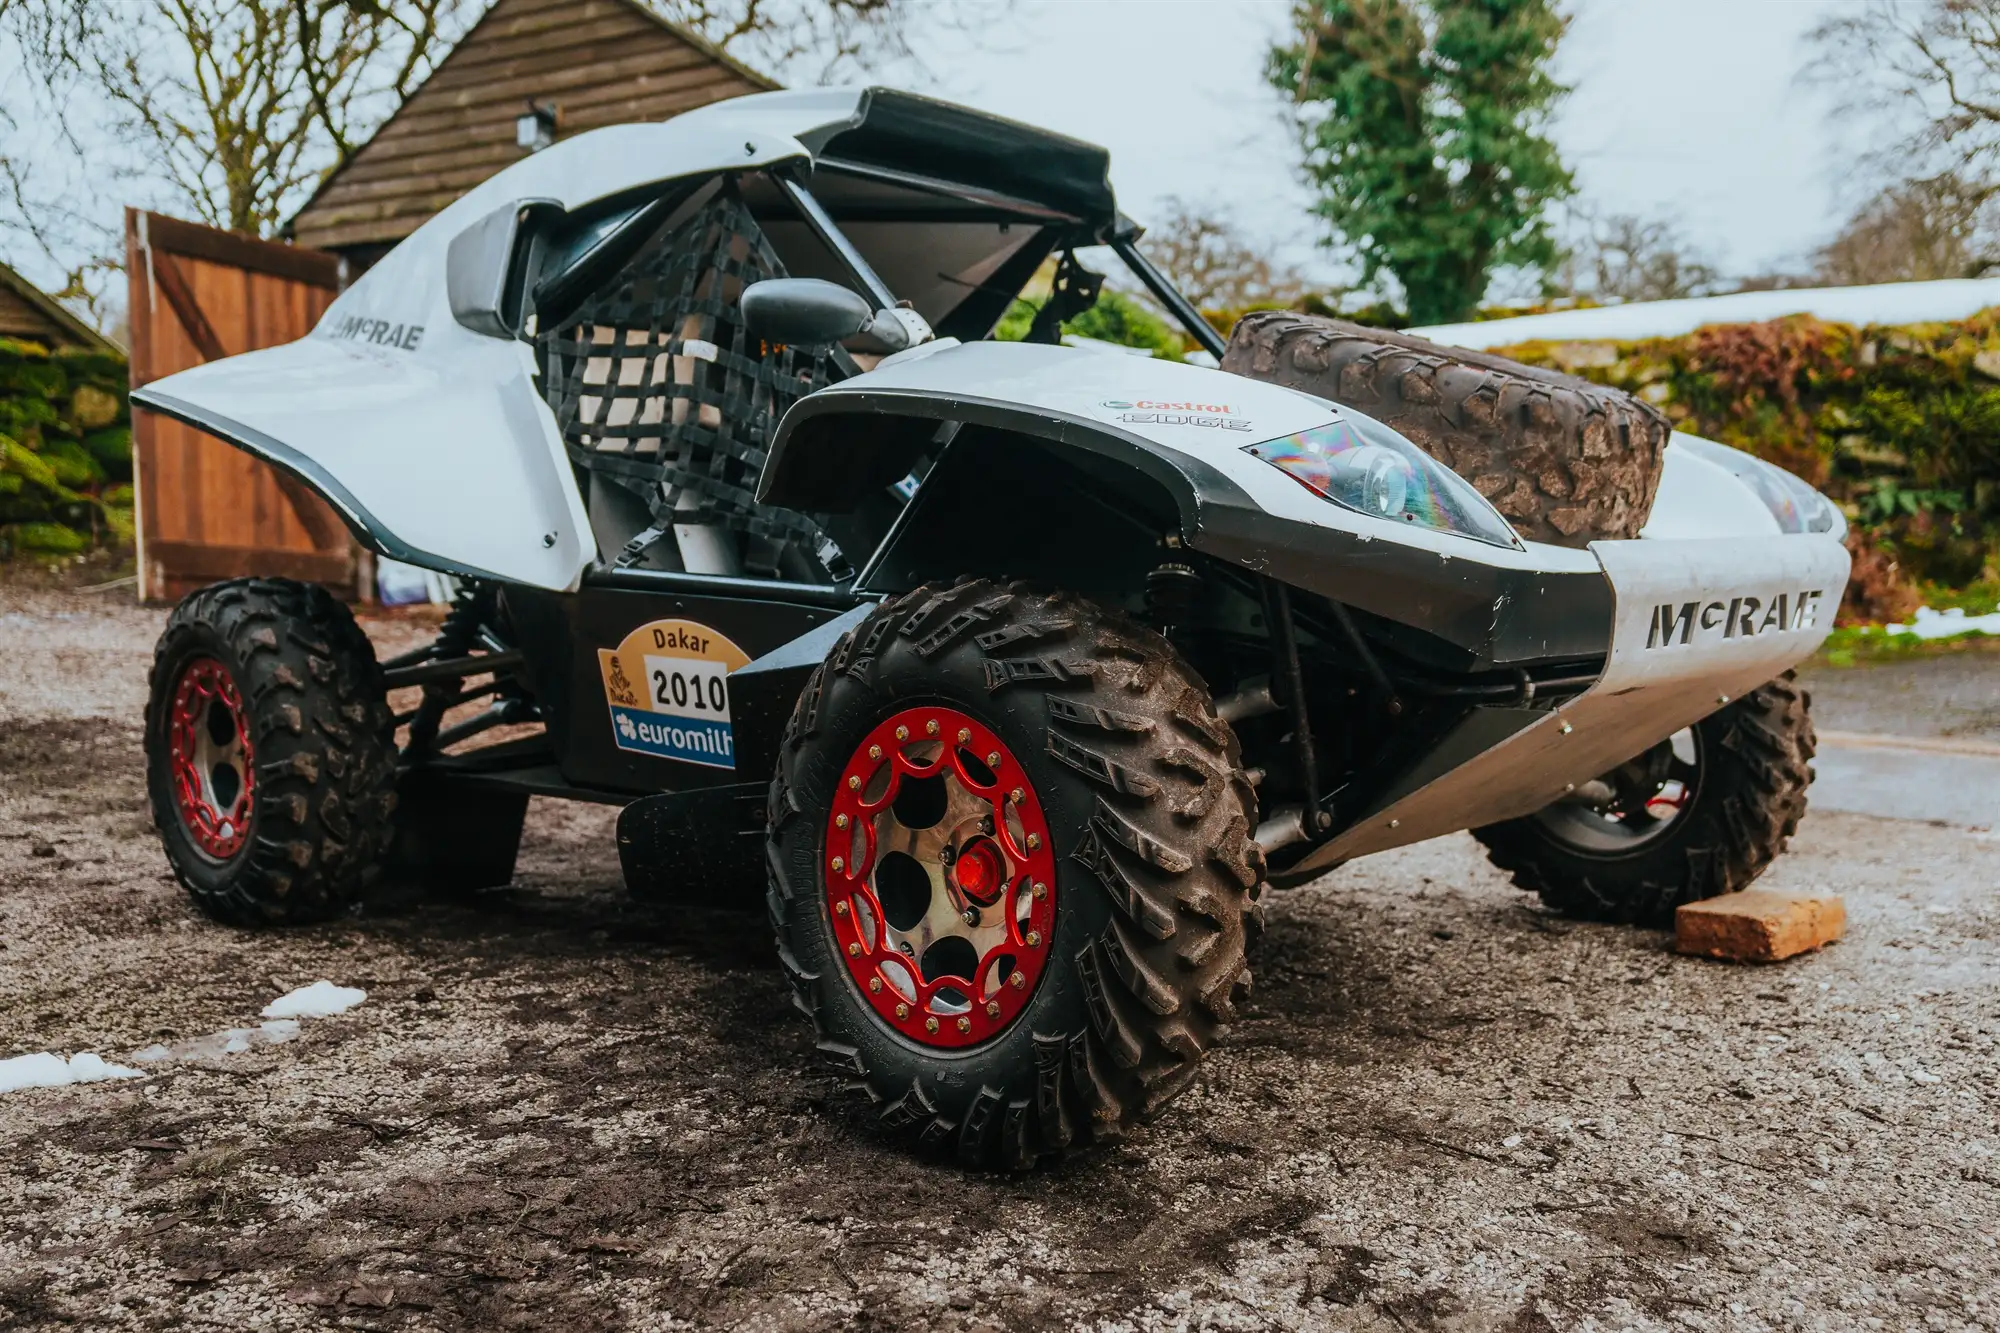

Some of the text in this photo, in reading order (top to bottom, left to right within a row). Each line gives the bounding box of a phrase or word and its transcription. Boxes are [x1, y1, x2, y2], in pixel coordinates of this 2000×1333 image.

[1136, 400, 1232, 413] Castrol
[1116, 413, 1253, 432] EDGE
[653, 628, 710, 654] Dakar
[653, 669, 726, 713] 2010
